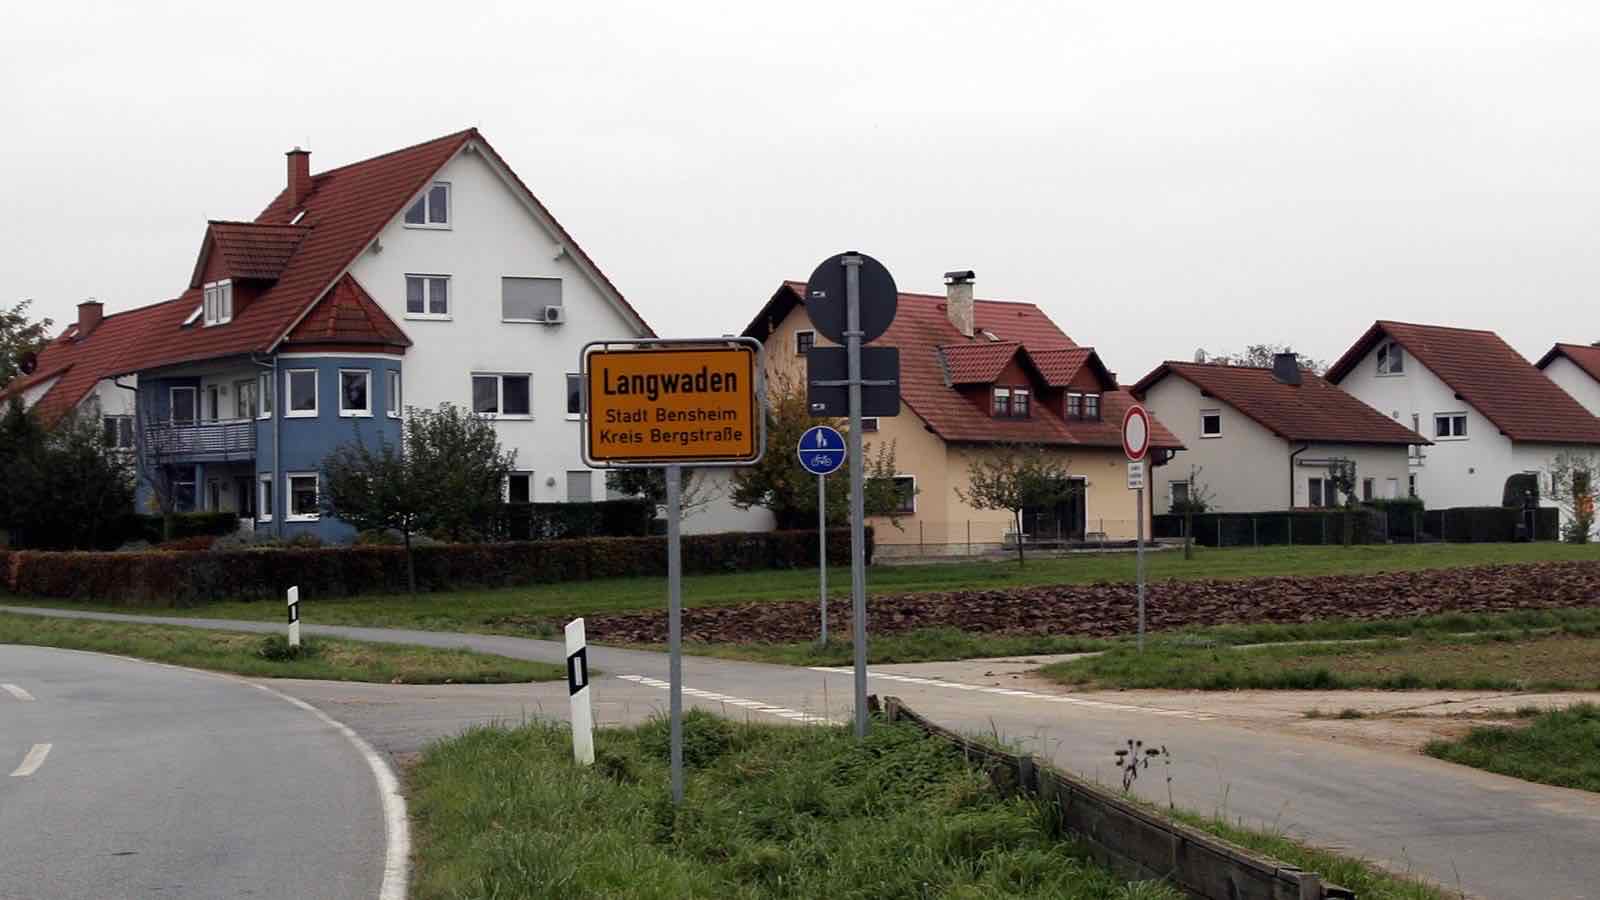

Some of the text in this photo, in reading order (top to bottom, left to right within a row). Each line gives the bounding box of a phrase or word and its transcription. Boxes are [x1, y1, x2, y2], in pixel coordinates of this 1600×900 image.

[604, 366, 737, 401] Langwaden
[605, 406, 737, 423] Stadt Bensheim
[600, 427, 743, 446] Kreis Bergstraße
